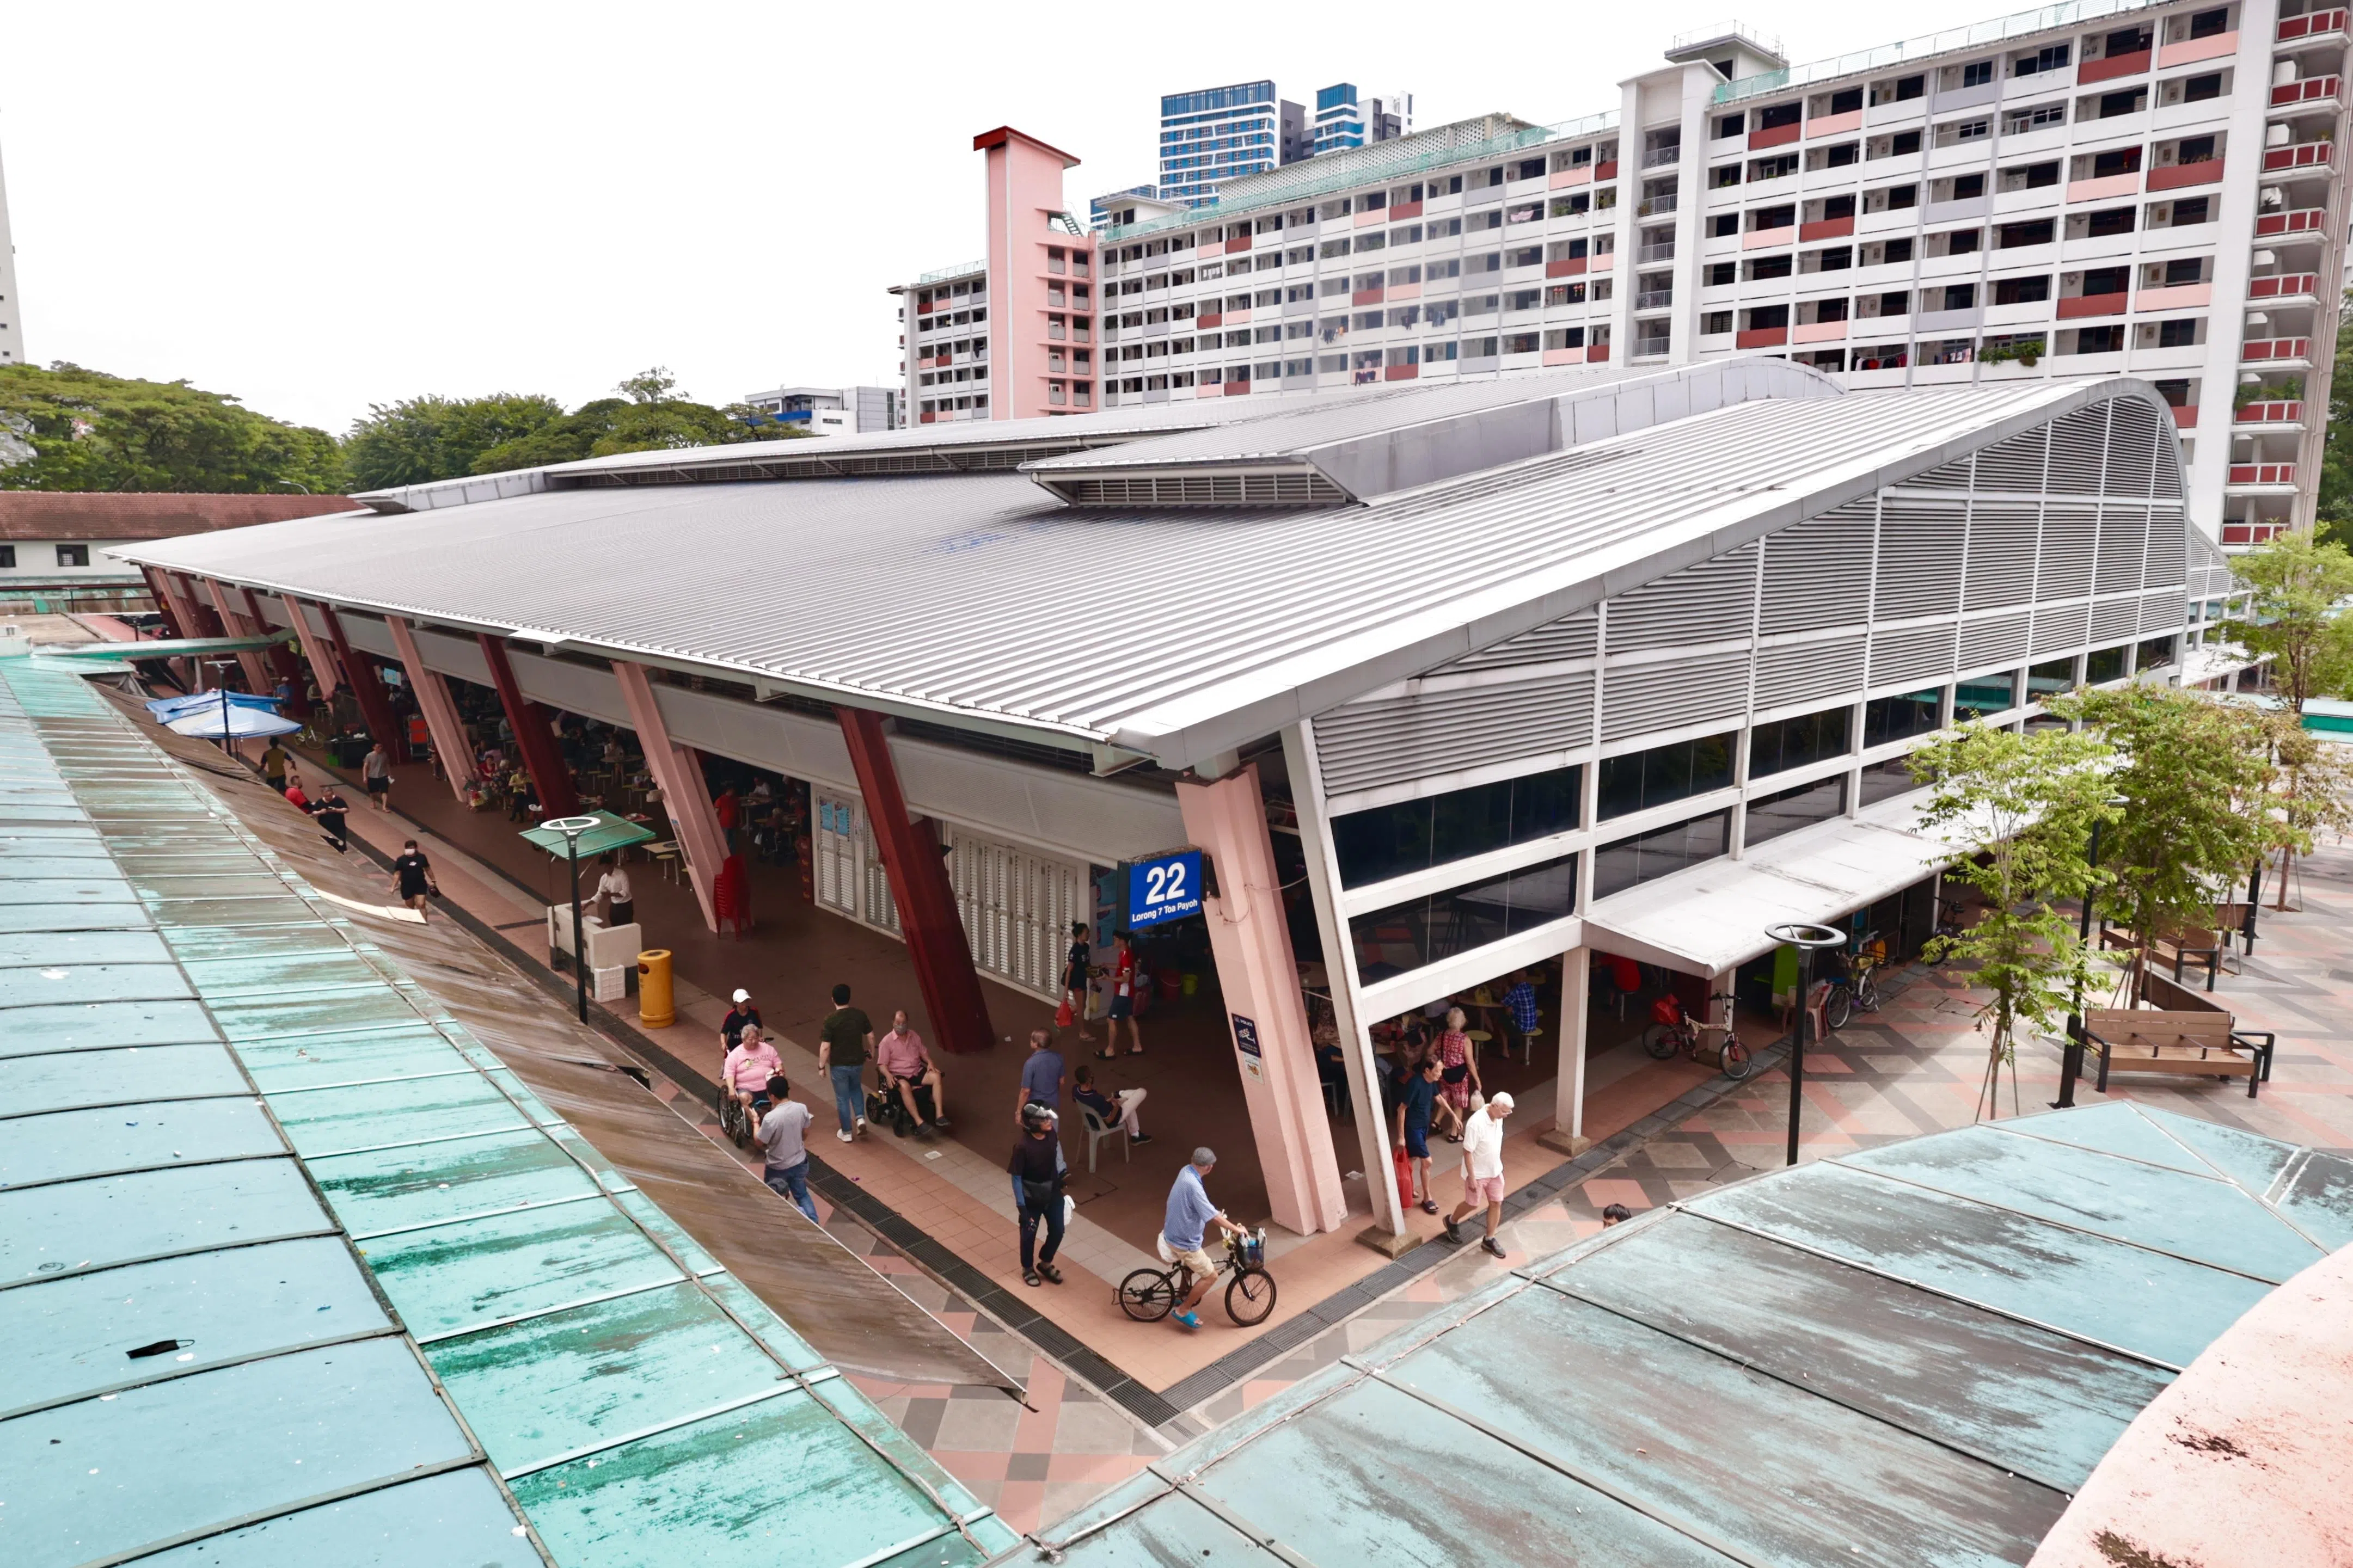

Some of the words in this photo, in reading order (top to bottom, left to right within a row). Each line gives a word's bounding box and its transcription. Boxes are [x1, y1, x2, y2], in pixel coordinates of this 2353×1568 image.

[1146, 862, 1185, 905] 22
[1132, 910, 1157, 923] Lorong
[1159, 907, 1163, 916] 7
[1164, 905, 1176, 914] Toa
[1177, 899, 1198, 911] Payoh
